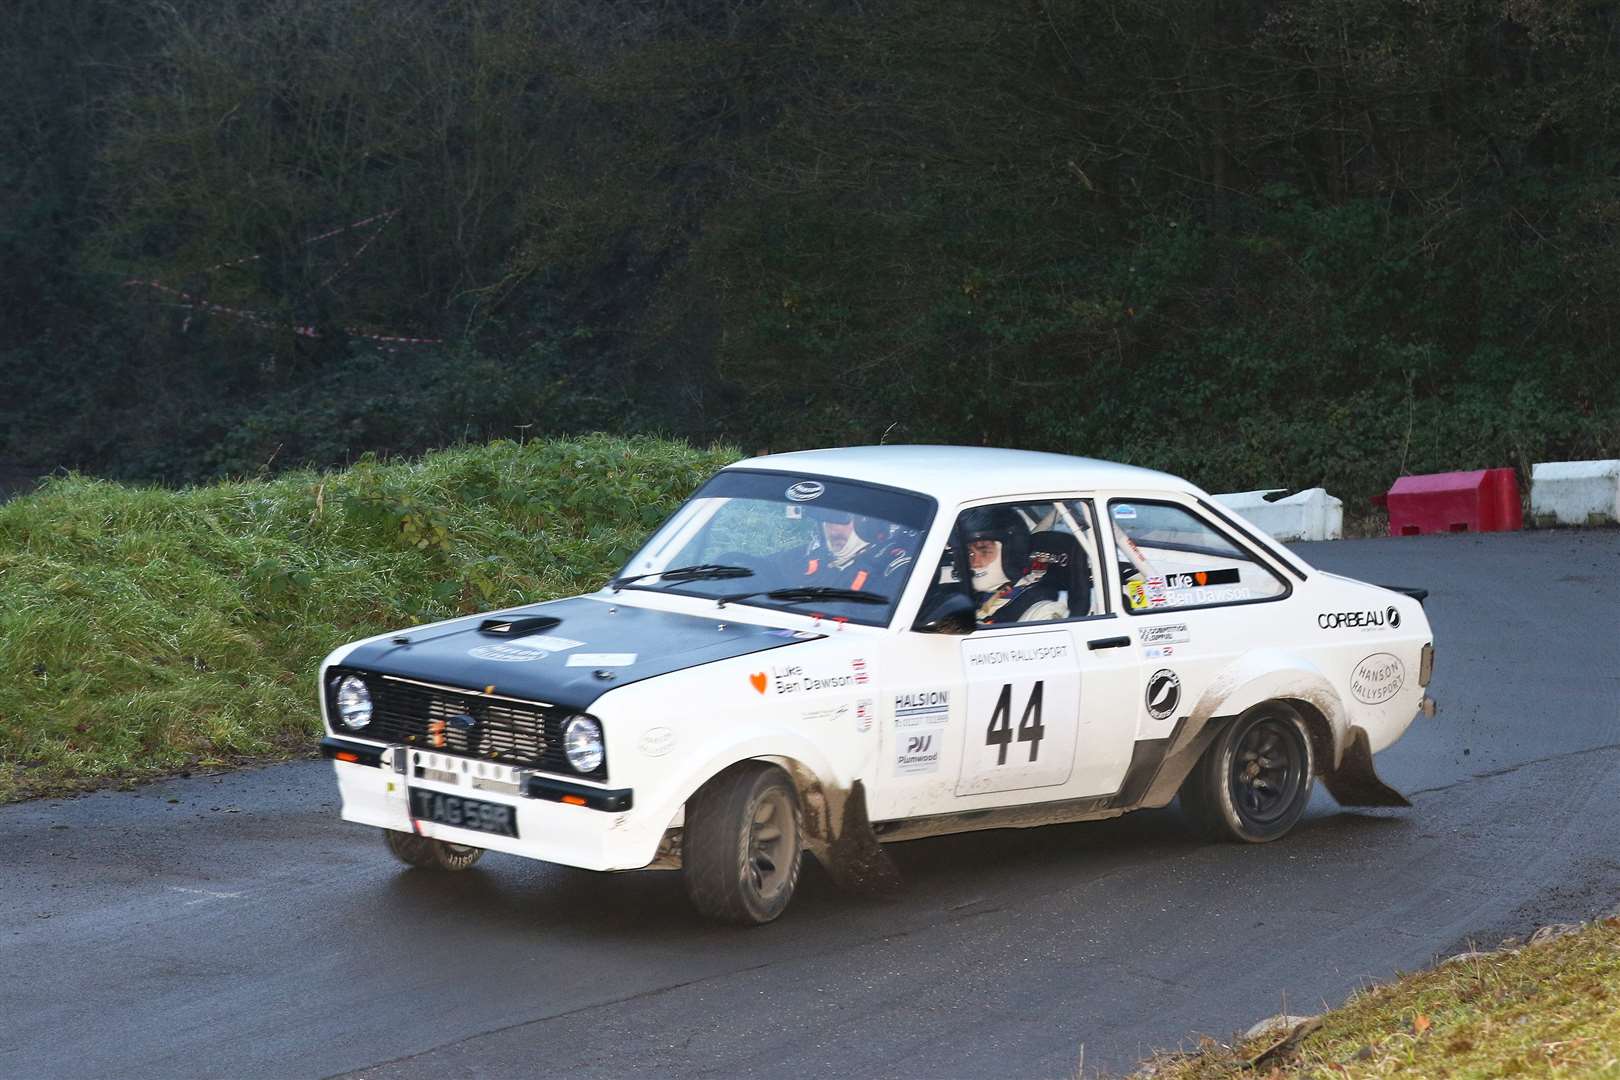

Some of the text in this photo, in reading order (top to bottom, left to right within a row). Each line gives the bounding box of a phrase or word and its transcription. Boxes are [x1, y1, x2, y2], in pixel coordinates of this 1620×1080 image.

[1167, 587, 1249, 604] Ben Dawson
[1318, 611, 1384, 629] CORBEAU
[970, 645, 1068, 665] HANSON RALLYSPORT
[772, 665, 803, 679] Luke
[1359, 661, 1399, 681] HANSON
[775, 675, 855, 694] Ben Dawson
[1352, 676, 1402, 699] RALLYSPORT
[896, 691, 948, 709] HALSION
[985, 680, 1045, 766] 44
[898, 752, 938, 764] Plumwood
[418, 791, 461, 824] TAG
